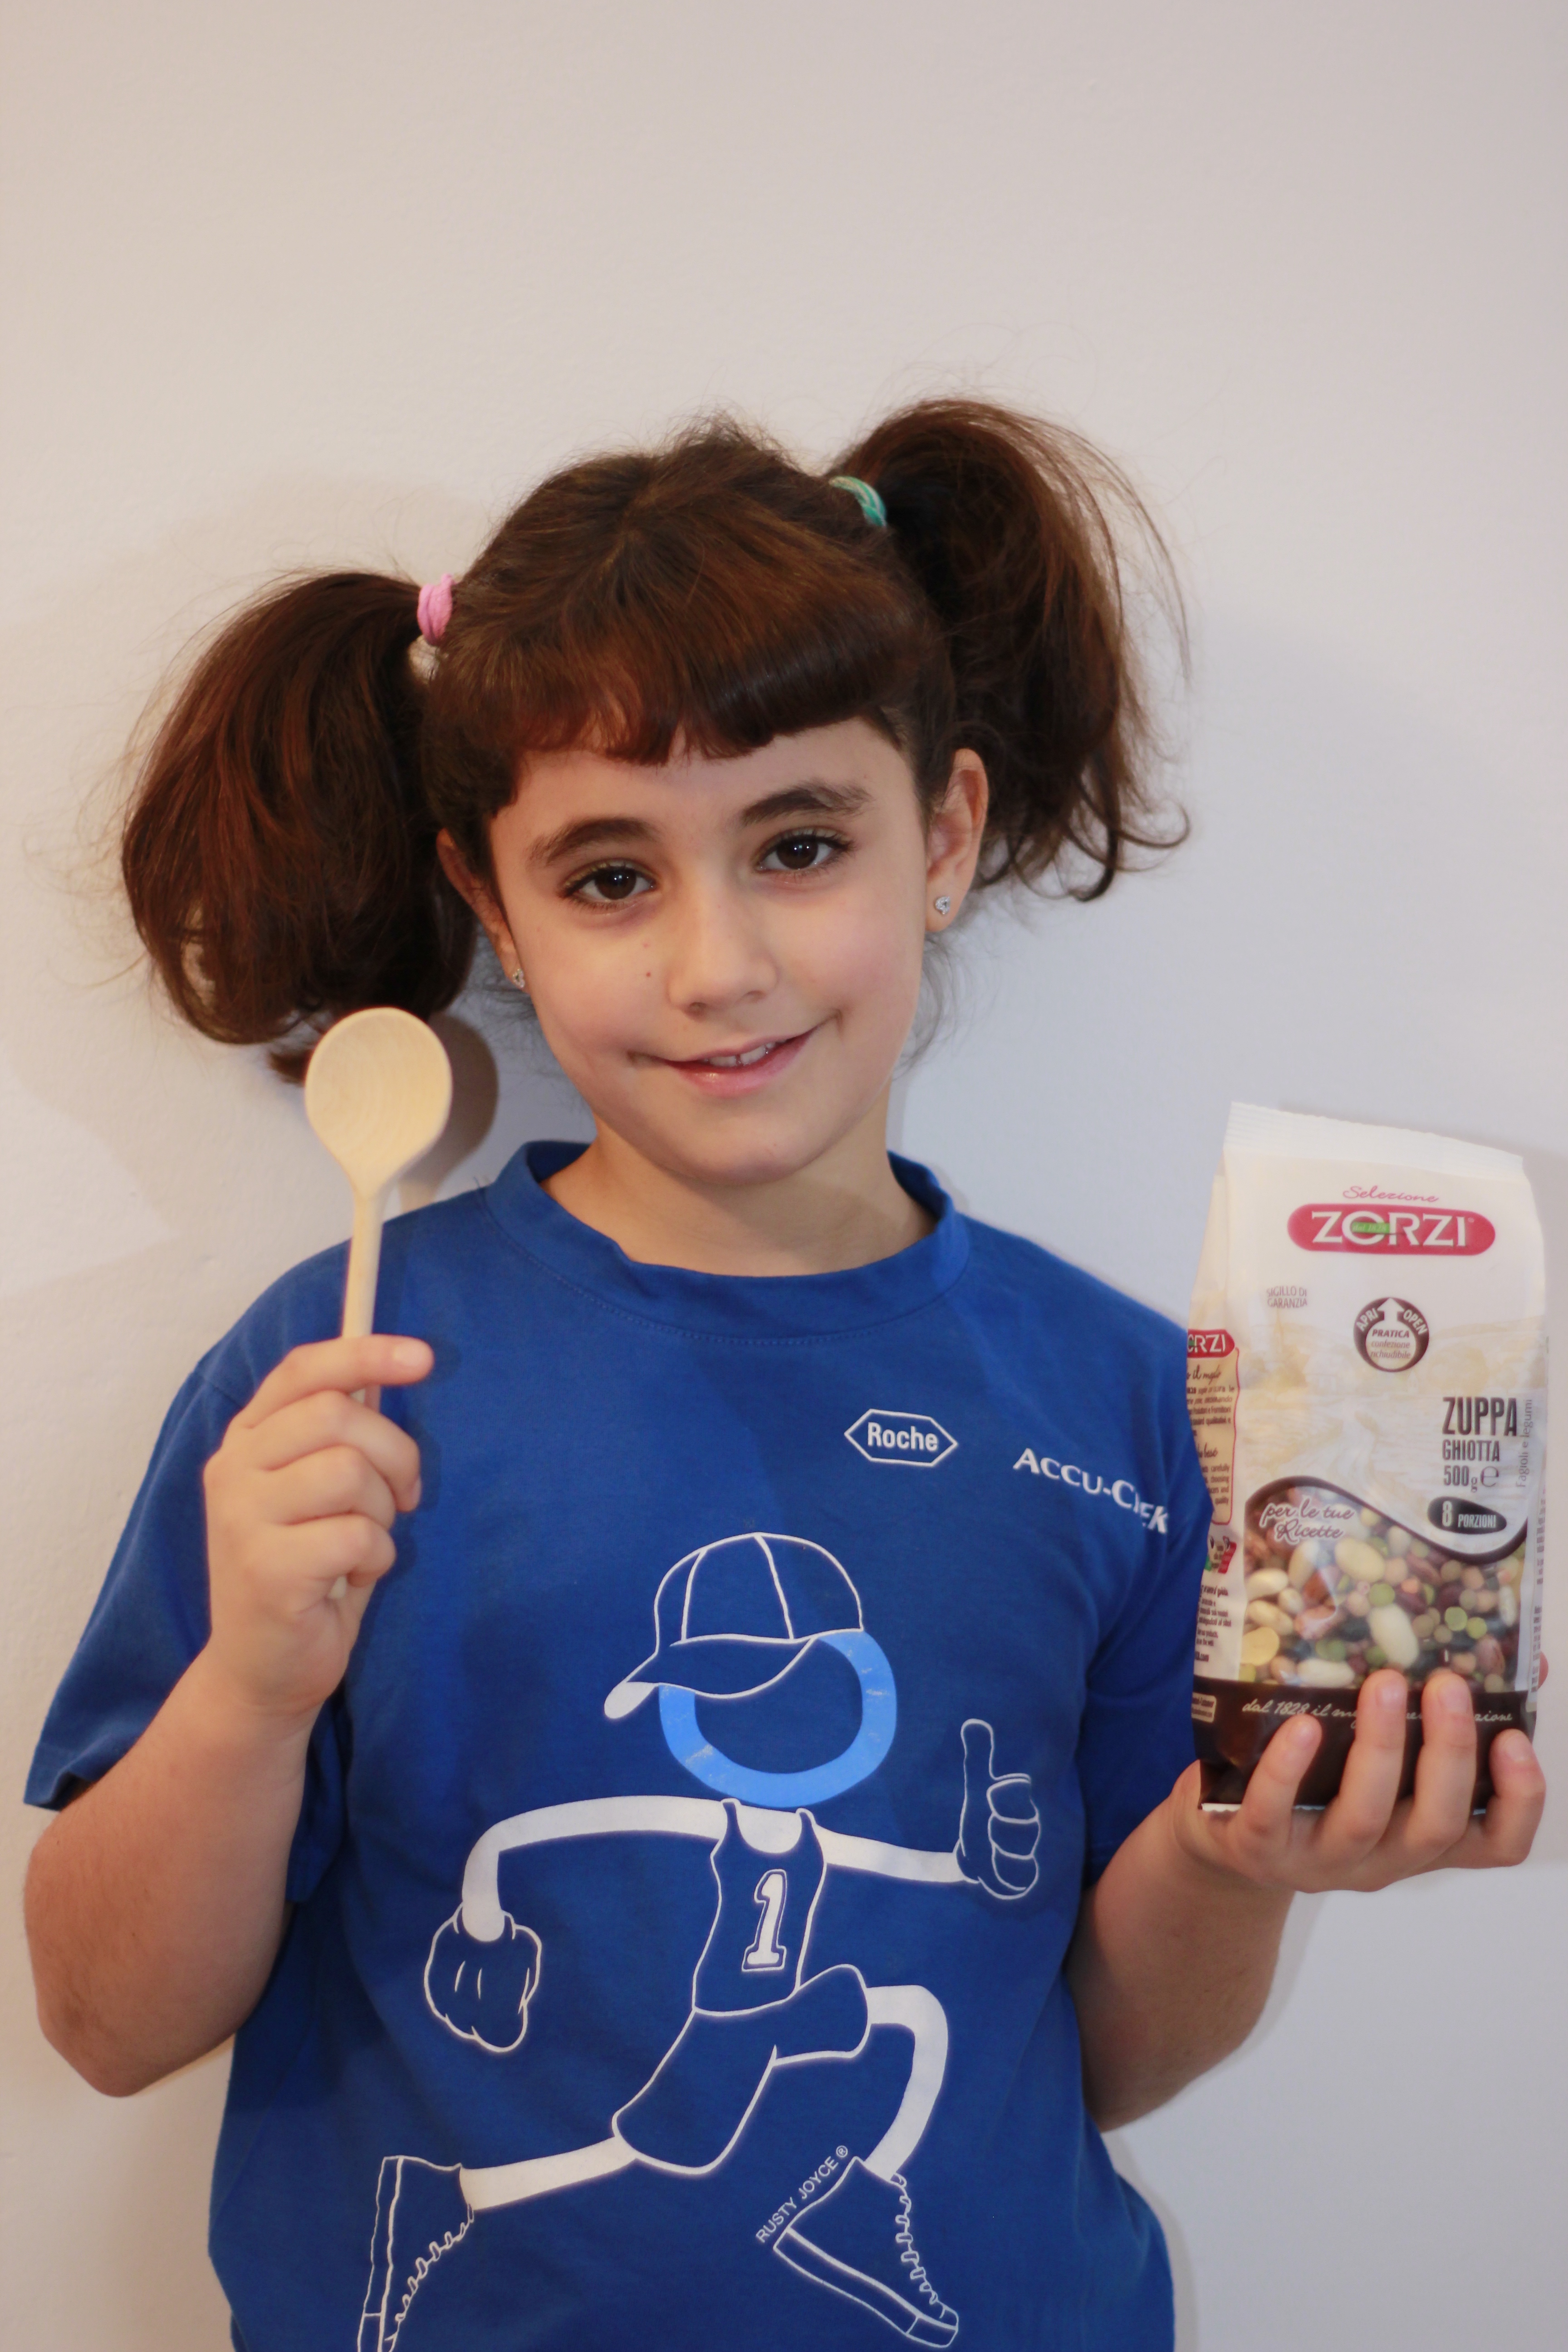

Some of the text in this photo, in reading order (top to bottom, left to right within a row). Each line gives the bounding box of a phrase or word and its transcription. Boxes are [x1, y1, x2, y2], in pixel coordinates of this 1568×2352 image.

[1343, 1186, 1439, 1202] Selezione
[1312, 1210, 1467, 1247] ZORZI
[1266, 1285, 1307, 1297] SIGILLO DI
[1267, 1298, 1307, 1308] GARANZIA
[1356, 1308, 1428, 1335] APRI OPEN
[1372, 1329, 1410, 1338] PRATICA
[1371, 1339, 1411, 1348] confezione
[1371, 1349, 1411, 1359] richiudibile
[1442, 1396, 1518, 1437] ZUPPA
[1520, 1399, 1534, 1438] legumi
[867, 1421, 939, 1451] Roche
[1442, 1439, 1500, 1462] GHIOTTA
[1516, 1451, 1530, 1488] Fagioli
[1260, 1498, 1355, 1527] per le tue
[1441, 1500, 1497, 1529] 8 PORZIONI
[1276, 1519, 1344, 1543] Ricette
[1242, 1698, 1274, 1713] dal
[741, 1868, 787, 1972] 1
[755, 2196, 797, 2244] RUSTY
[798, 2156, 839, 2200] JOYCE
